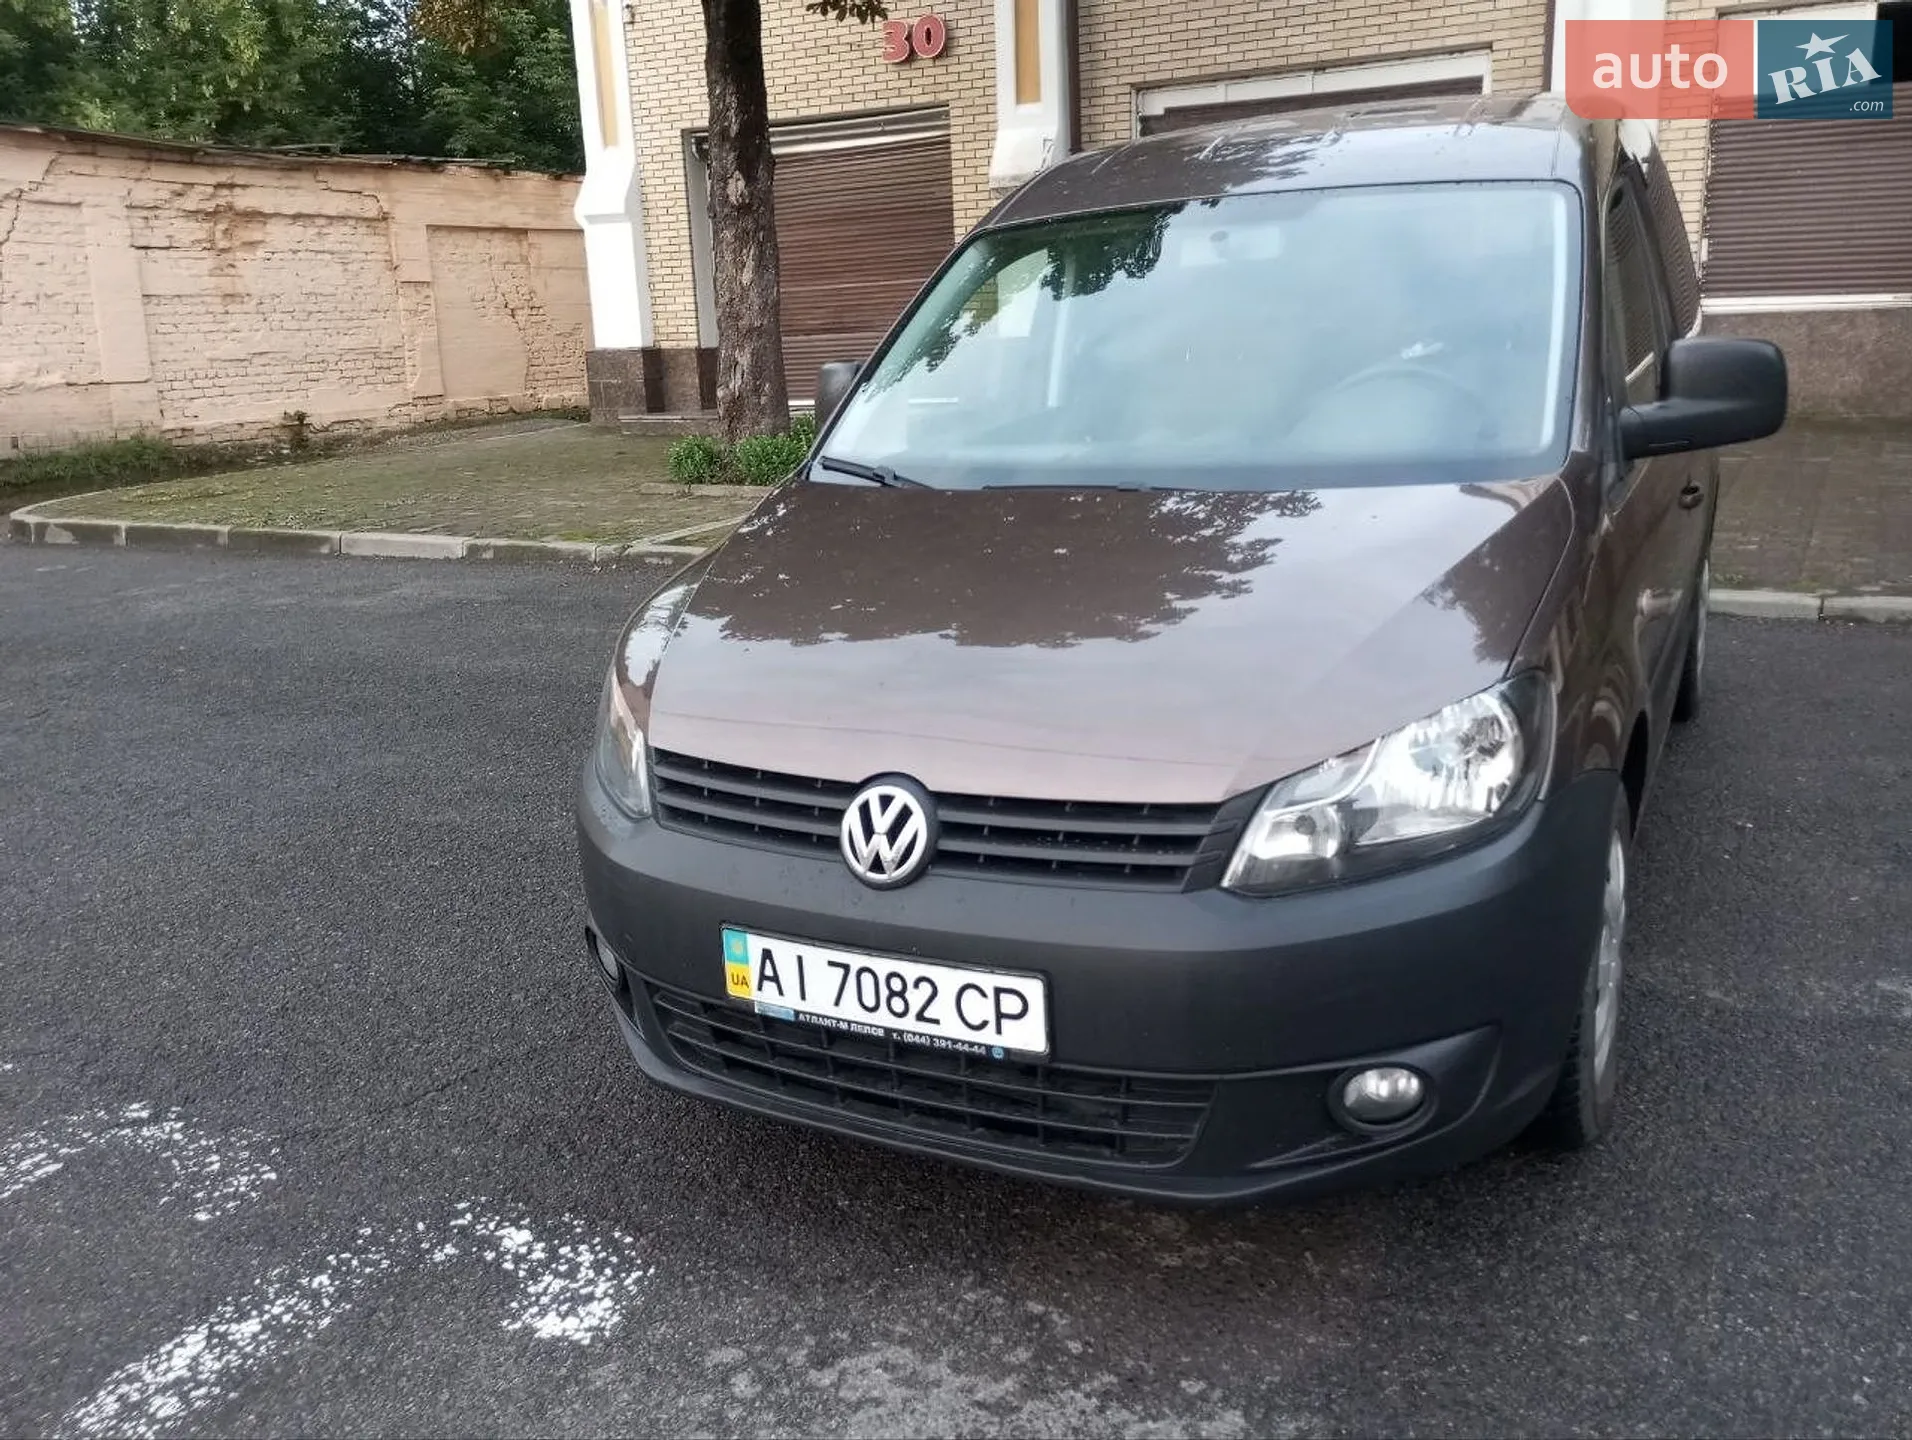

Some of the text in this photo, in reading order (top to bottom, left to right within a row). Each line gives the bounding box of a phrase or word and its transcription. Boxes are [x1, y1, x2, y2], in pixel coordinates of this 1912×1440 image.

[882, 12, 946, 63] 30
[731, 971, 749, 988] UA
[827, 960, 941, 1025] 7082
[955, 983, 1029, 1035] CP
